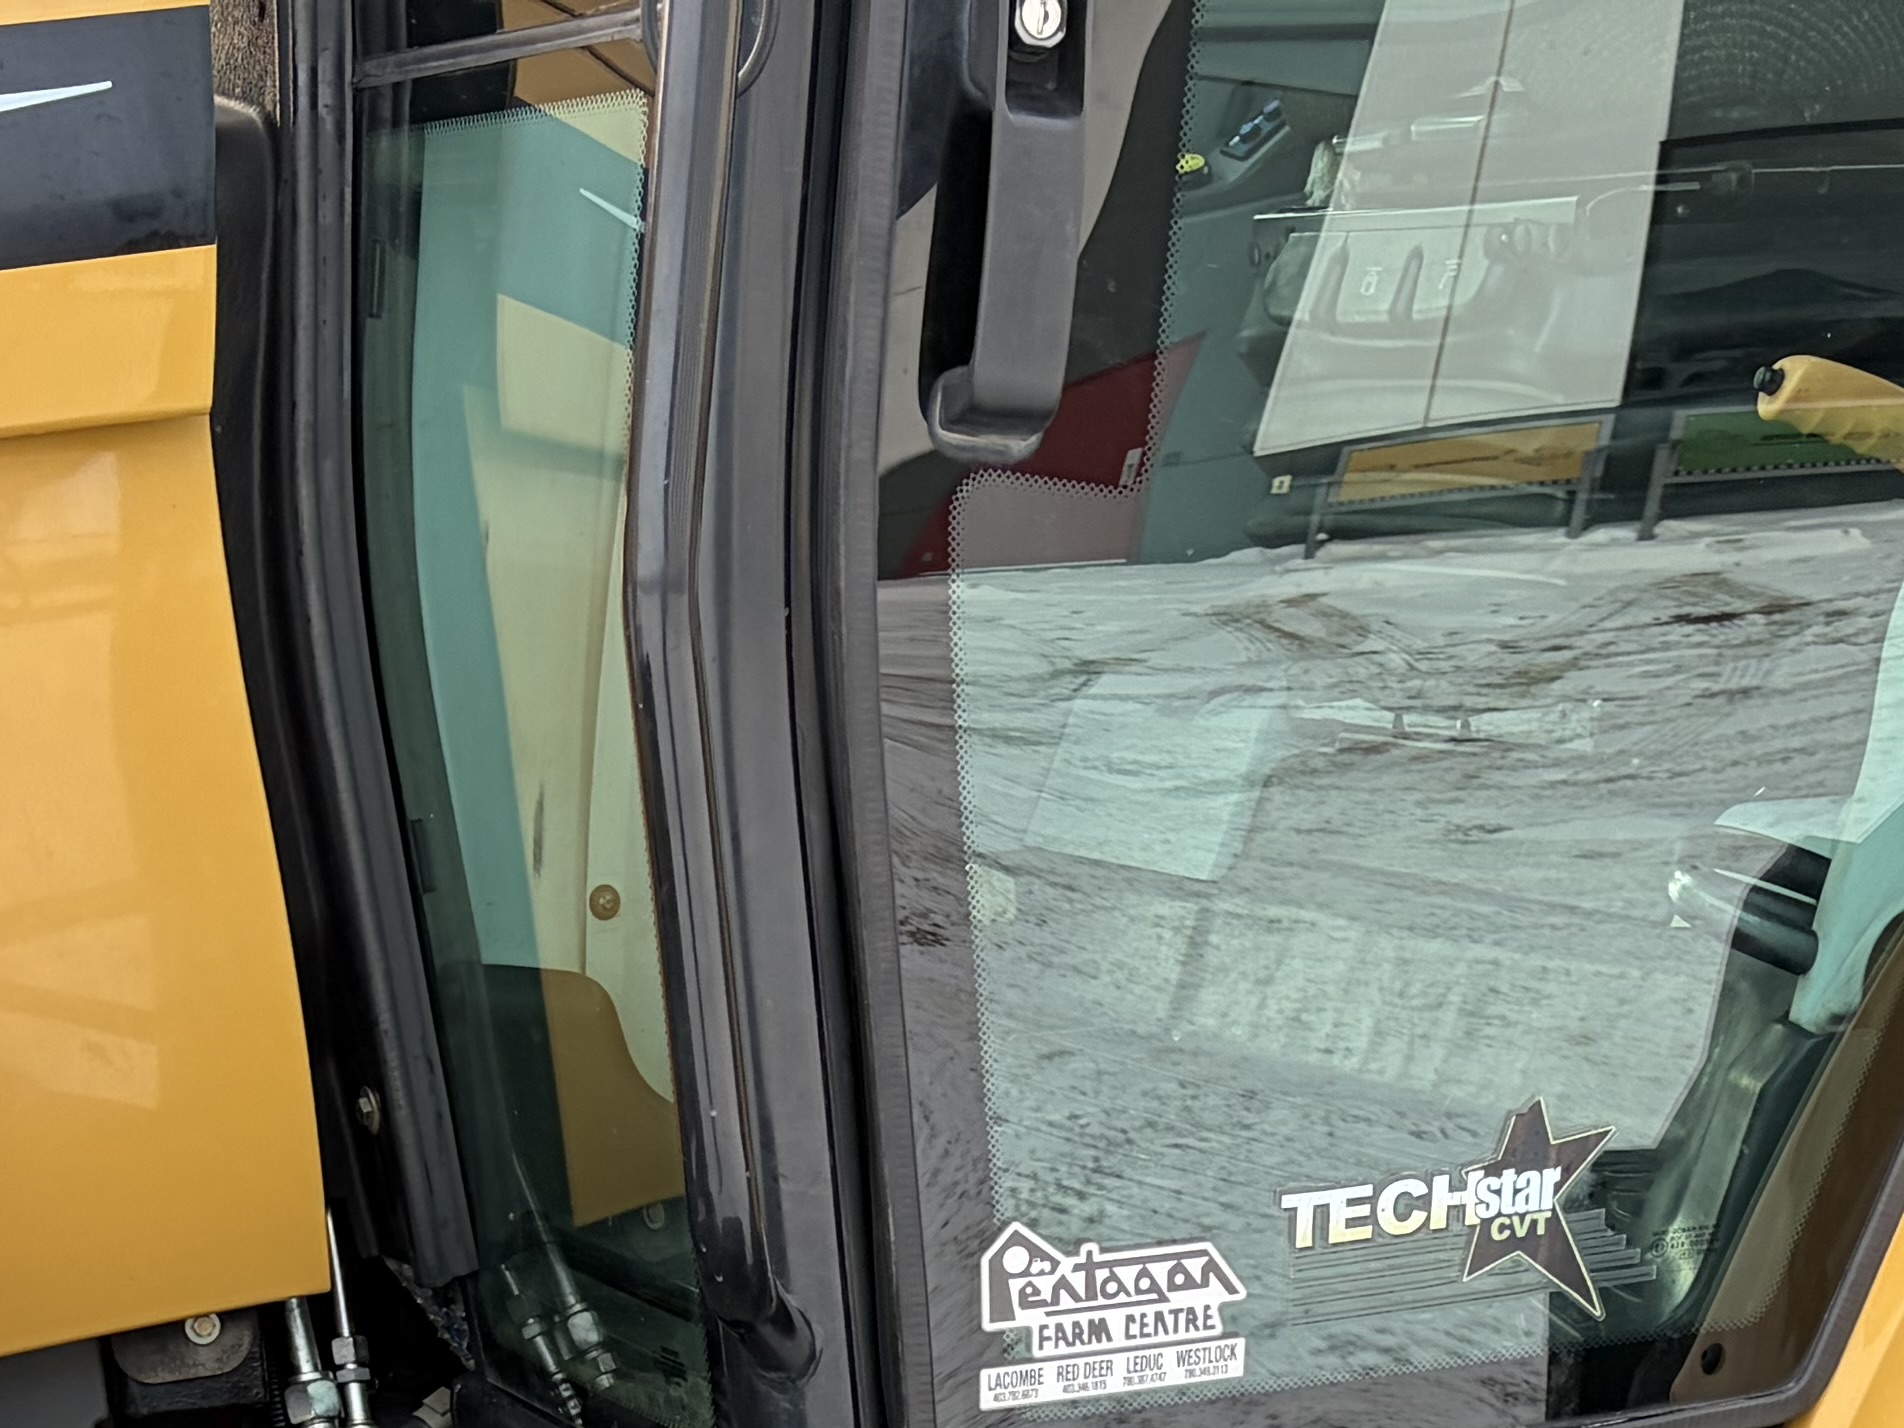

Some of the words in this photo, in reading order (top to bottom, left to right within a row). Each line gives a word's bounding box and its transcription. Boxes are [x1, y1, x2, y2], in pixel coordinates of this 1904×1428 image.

[1489, 1210, 1553, 1242] CVT
[988, 1229, 1241, 1324] Pentagon
[1038, 1317, 1114, 1352] FARM
[1124, 1303, 1217, 1341] CENTRE
[987, 1367, 1045, 1392] LACOMBE
[1056, 1363, 1080, 1383] RED
[1083, 1359, 1114, 1380] DEER
[1126, 1352, 1164, 1375] LEDUC
[1176, 1342, 1238, 1368] WESTLOCK
